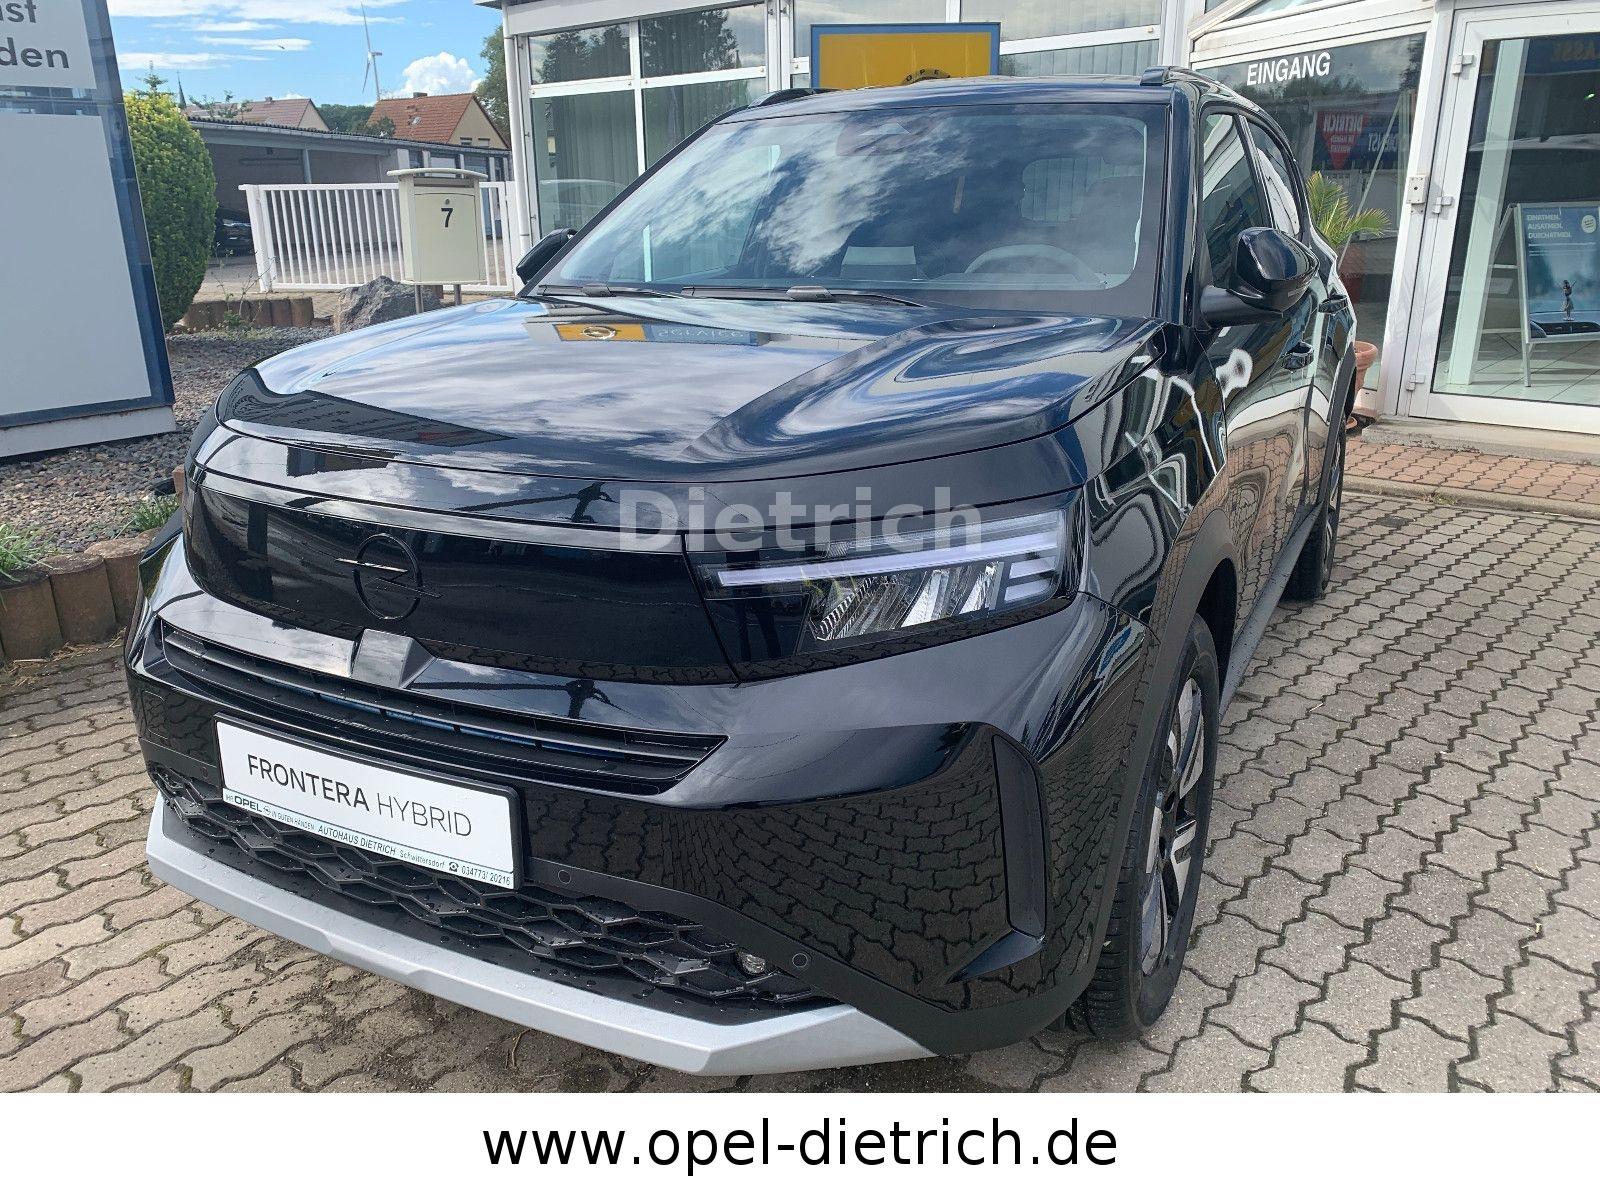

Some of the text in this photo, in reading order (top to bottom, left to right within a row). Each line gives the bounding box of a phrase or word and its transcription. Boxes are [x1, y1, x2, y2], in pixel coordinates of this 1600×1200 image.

[0, 0, 37, 23] st
[905, 68, 951, 82] OPE
[1246, 51, 1331, 86] EINGANG
[440, 207, 454, 228] 7
[247, 753, 472, 837] FRONTERA HYBRID
[234, 795, 262, 812] OPEL
[318, 825, 359, 845] AUTOHAUS
[360, 837, 396, 856] DIETRICH
[490, 873, 511, 886] 20216
